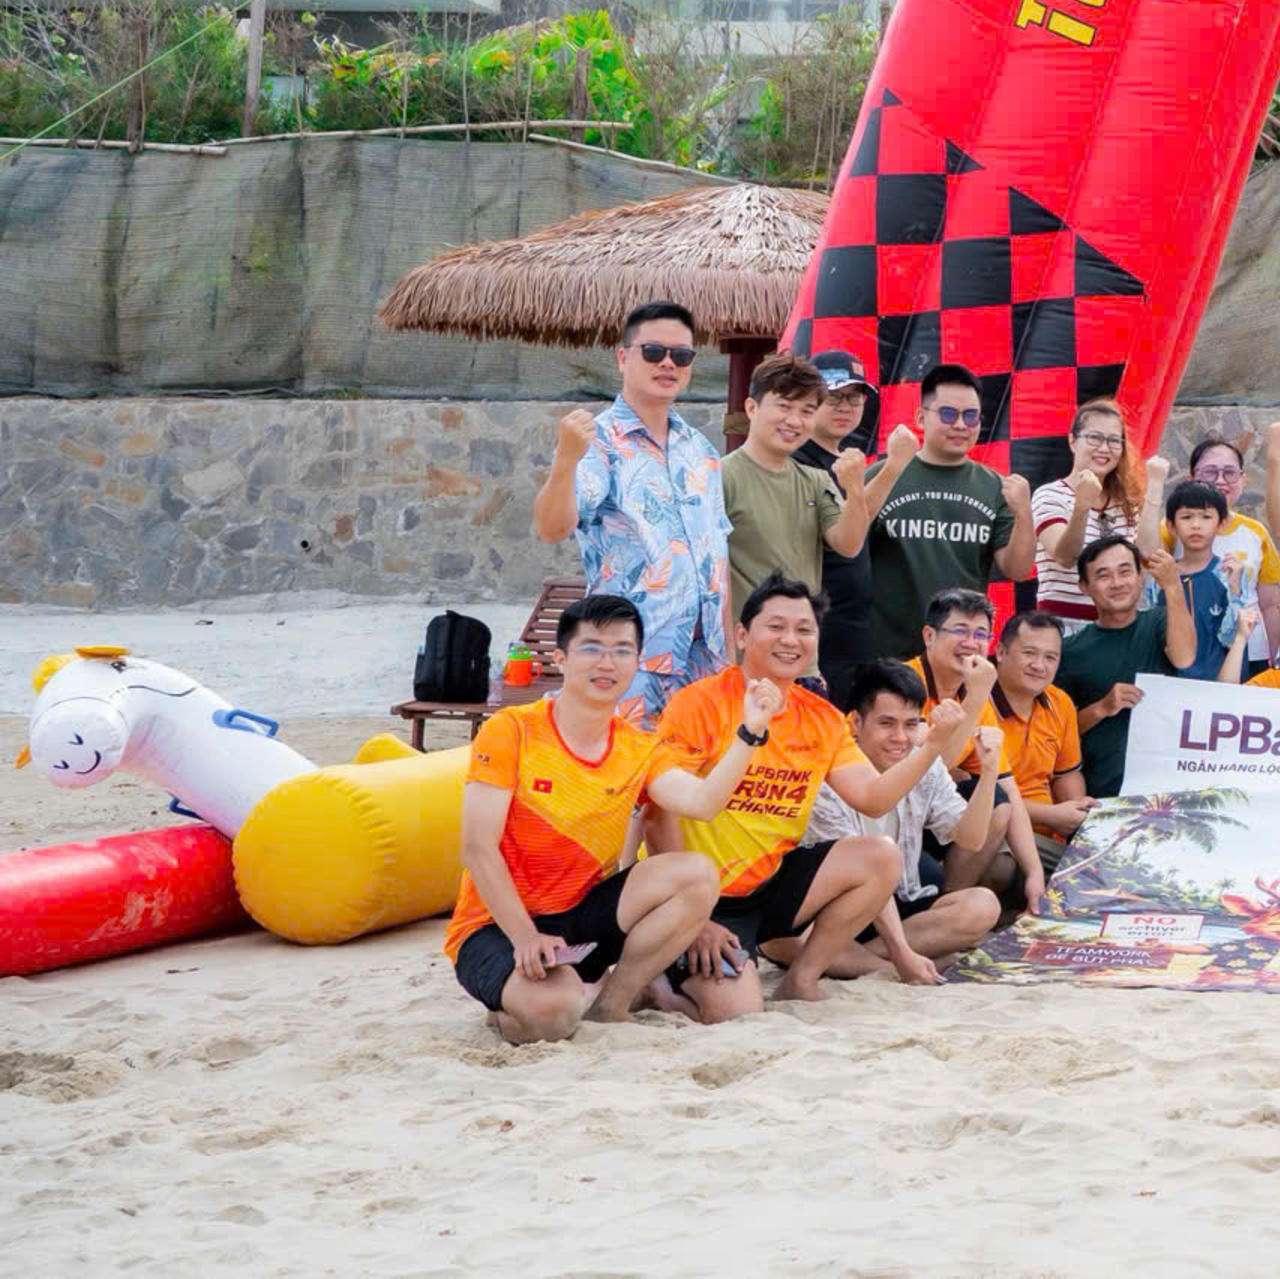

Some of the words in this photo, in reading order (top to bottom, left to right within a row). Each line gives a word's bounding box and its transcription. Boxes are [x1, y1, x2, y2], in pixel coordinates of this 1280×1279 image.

[886, 518, 991, 545] KINGKONG
[745, 763, 813, 783] LPBANK
[1177, 759, 1217, 773] NGÂN
[733, 779, 809, 804] RUN4
[725, 798, 802, 819] CHANGE
[1133, 916, 1177, 925] NO
[1055, 945, 1152, 958] TEAMWORK
